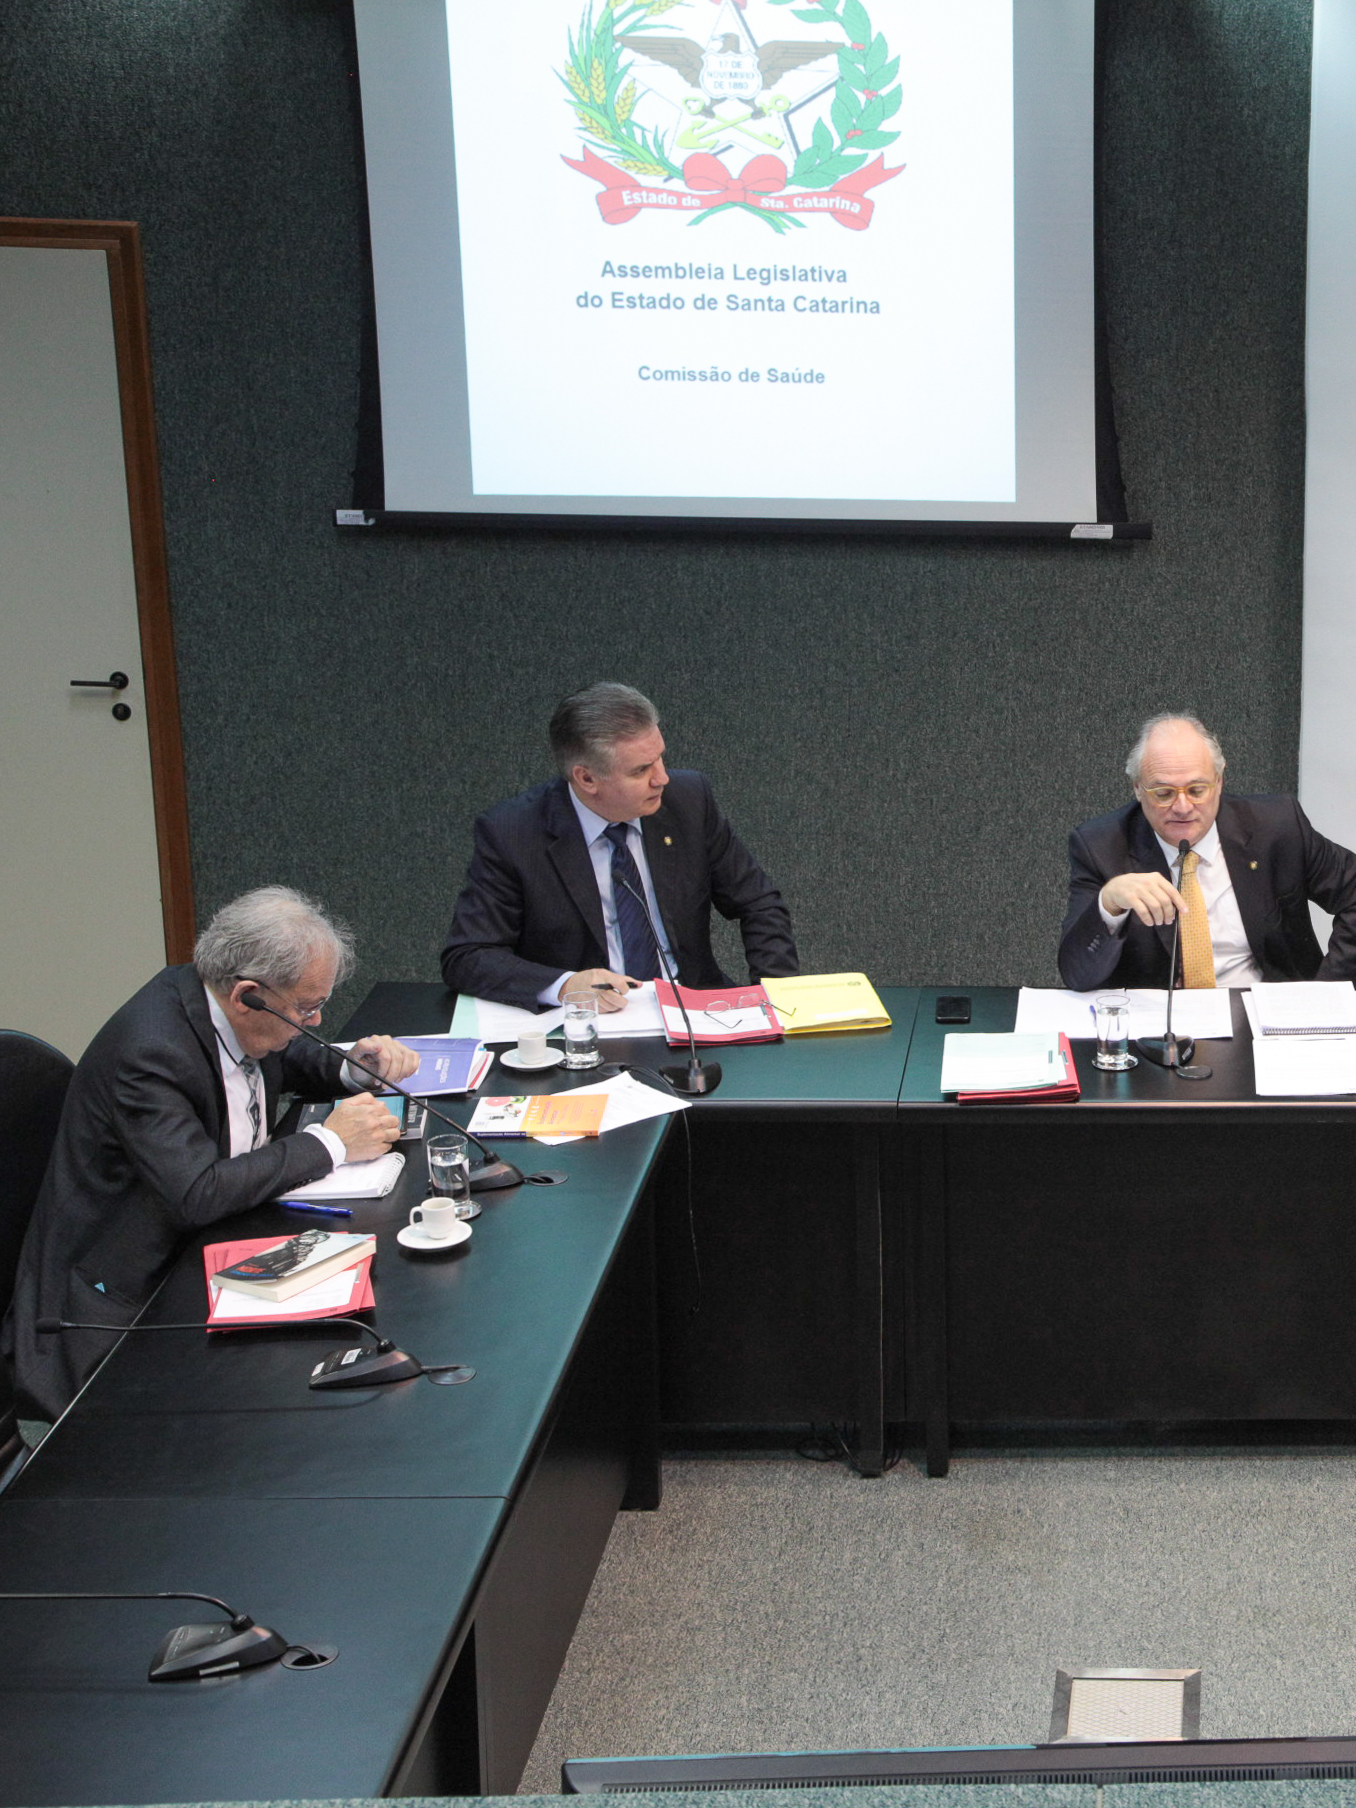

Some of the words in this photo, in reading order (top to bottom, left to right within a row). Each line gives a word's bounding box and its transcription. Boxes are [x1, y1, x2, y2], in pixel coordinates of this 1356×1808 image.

[731, 60, 743, 69] DE
[622, 189, 677, 206] Estado
[681, 195, 701, 208] de
[760, 197, 788, 209] Sta.
[792, 196, 861, 214] Catarina
[600, 260, 725, 280] Assembleia
[733, 263, 847, 286] Legislativa
[575, 291, 603, 309] do
[611, 291, 685, 310] Estado
[693, 293, 718, 311] de
[726, 294, 785, 312] Santa
[793, 295, 880, 315] Catarina
[638, 365, 732, 383] Comissão
[738, 367, 760, 383] de
[767, 367, 825, 384] Saúde
